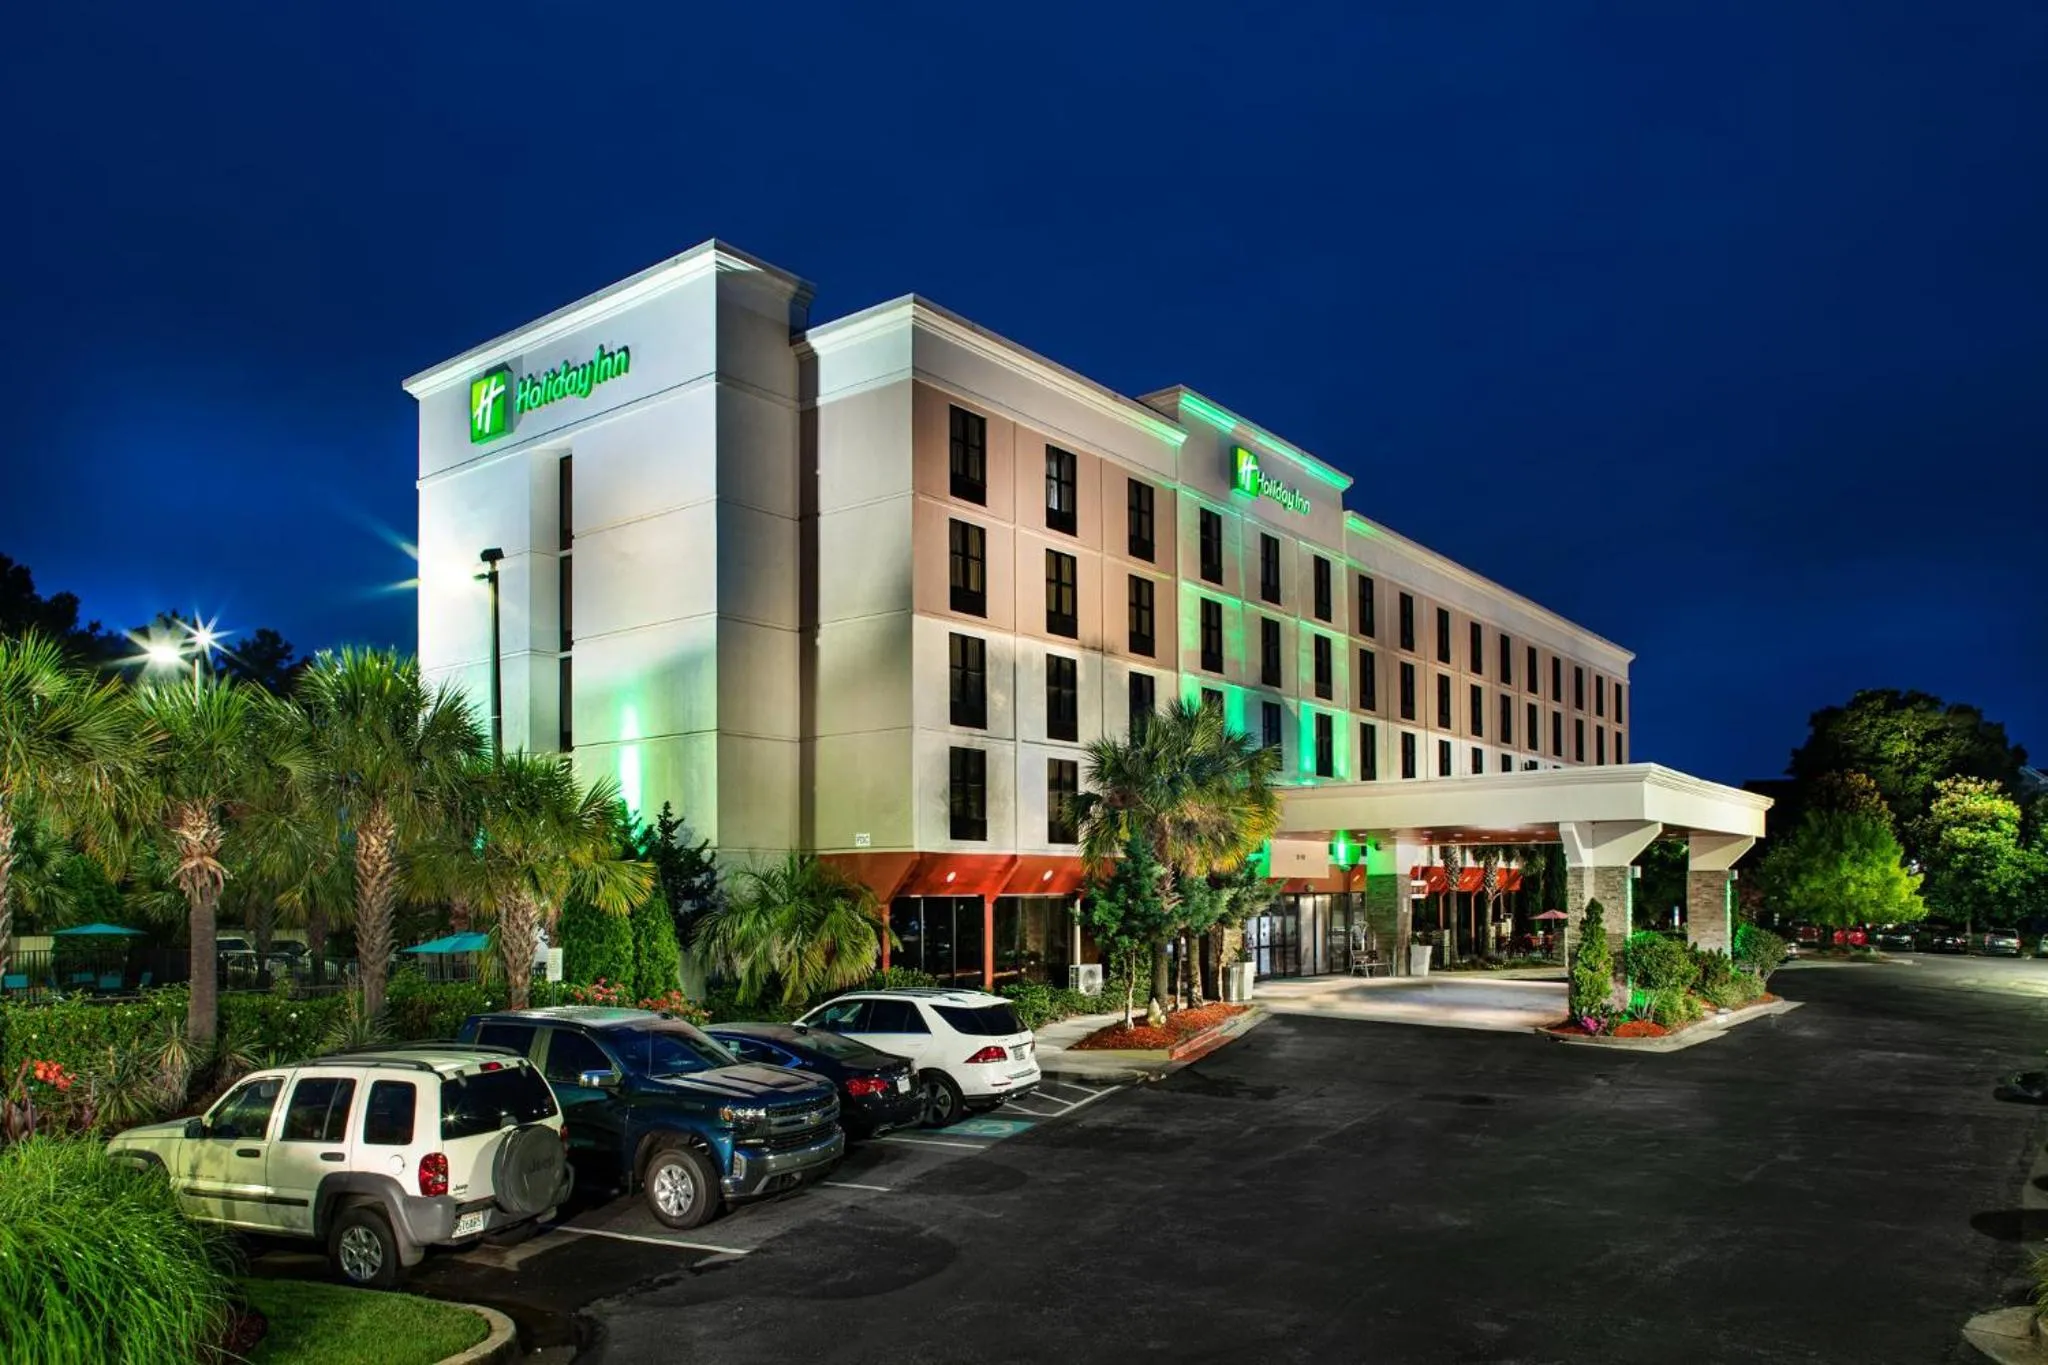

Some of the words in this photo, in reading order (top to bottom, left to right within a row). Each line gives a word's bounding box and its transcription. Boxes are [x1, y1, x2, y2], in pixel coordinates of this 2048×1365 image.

[516, 359, 595, 414] Holiday
[593, 343, 631, 384] Inn
[1257, 471, 1295, 511] Holiday
[1295, 488, 1312, 516] Inn
